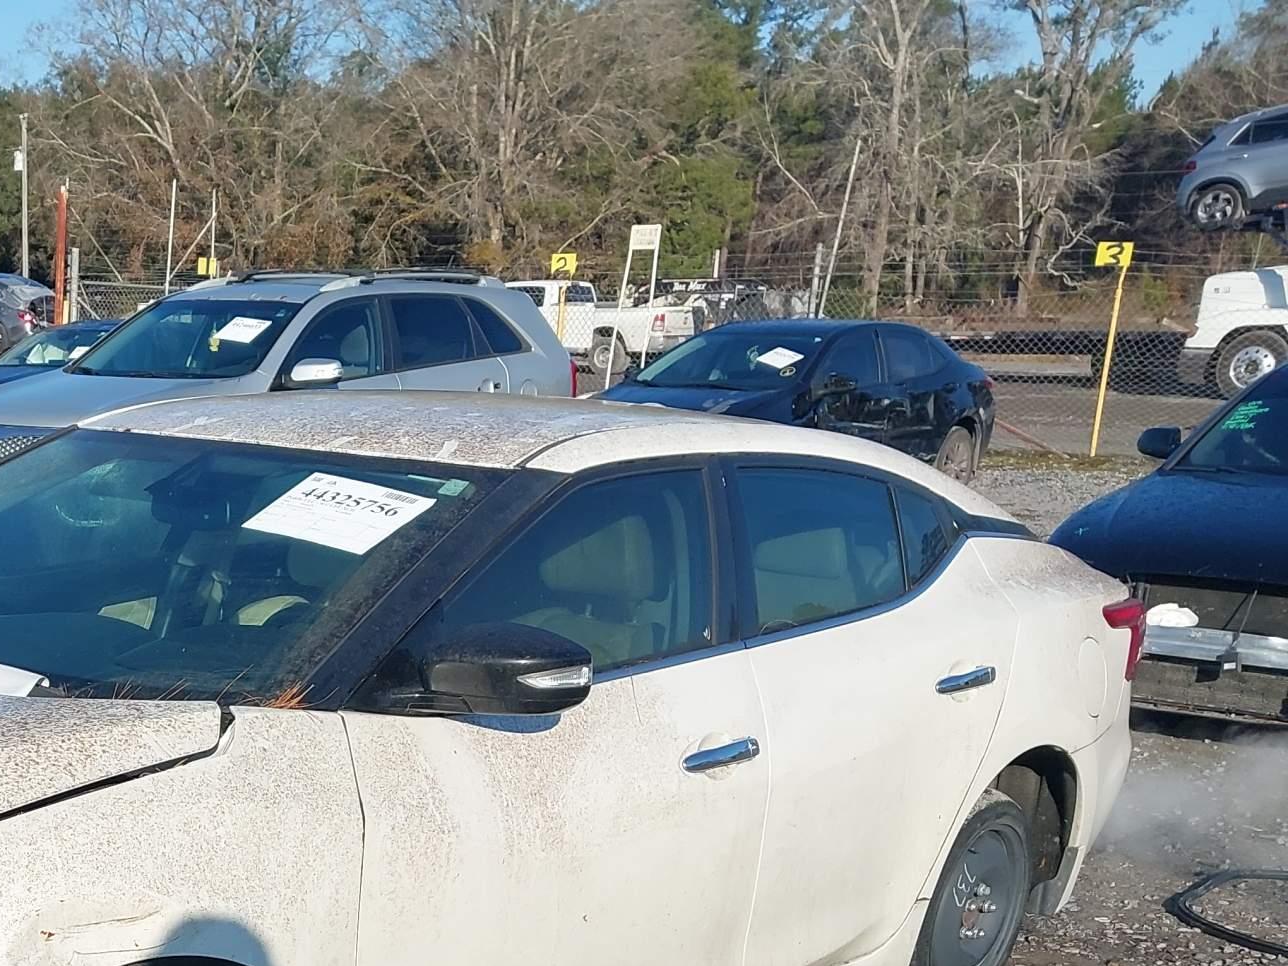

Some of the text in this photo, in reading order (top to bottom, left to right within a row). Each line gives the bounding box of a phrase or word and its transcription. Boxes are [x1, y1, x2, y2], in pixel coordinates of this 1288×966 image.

[555, 256, 570, 272] 2
[1105, 242, 1124, 266] 3
[301, 486, 403, 518] 44325756
